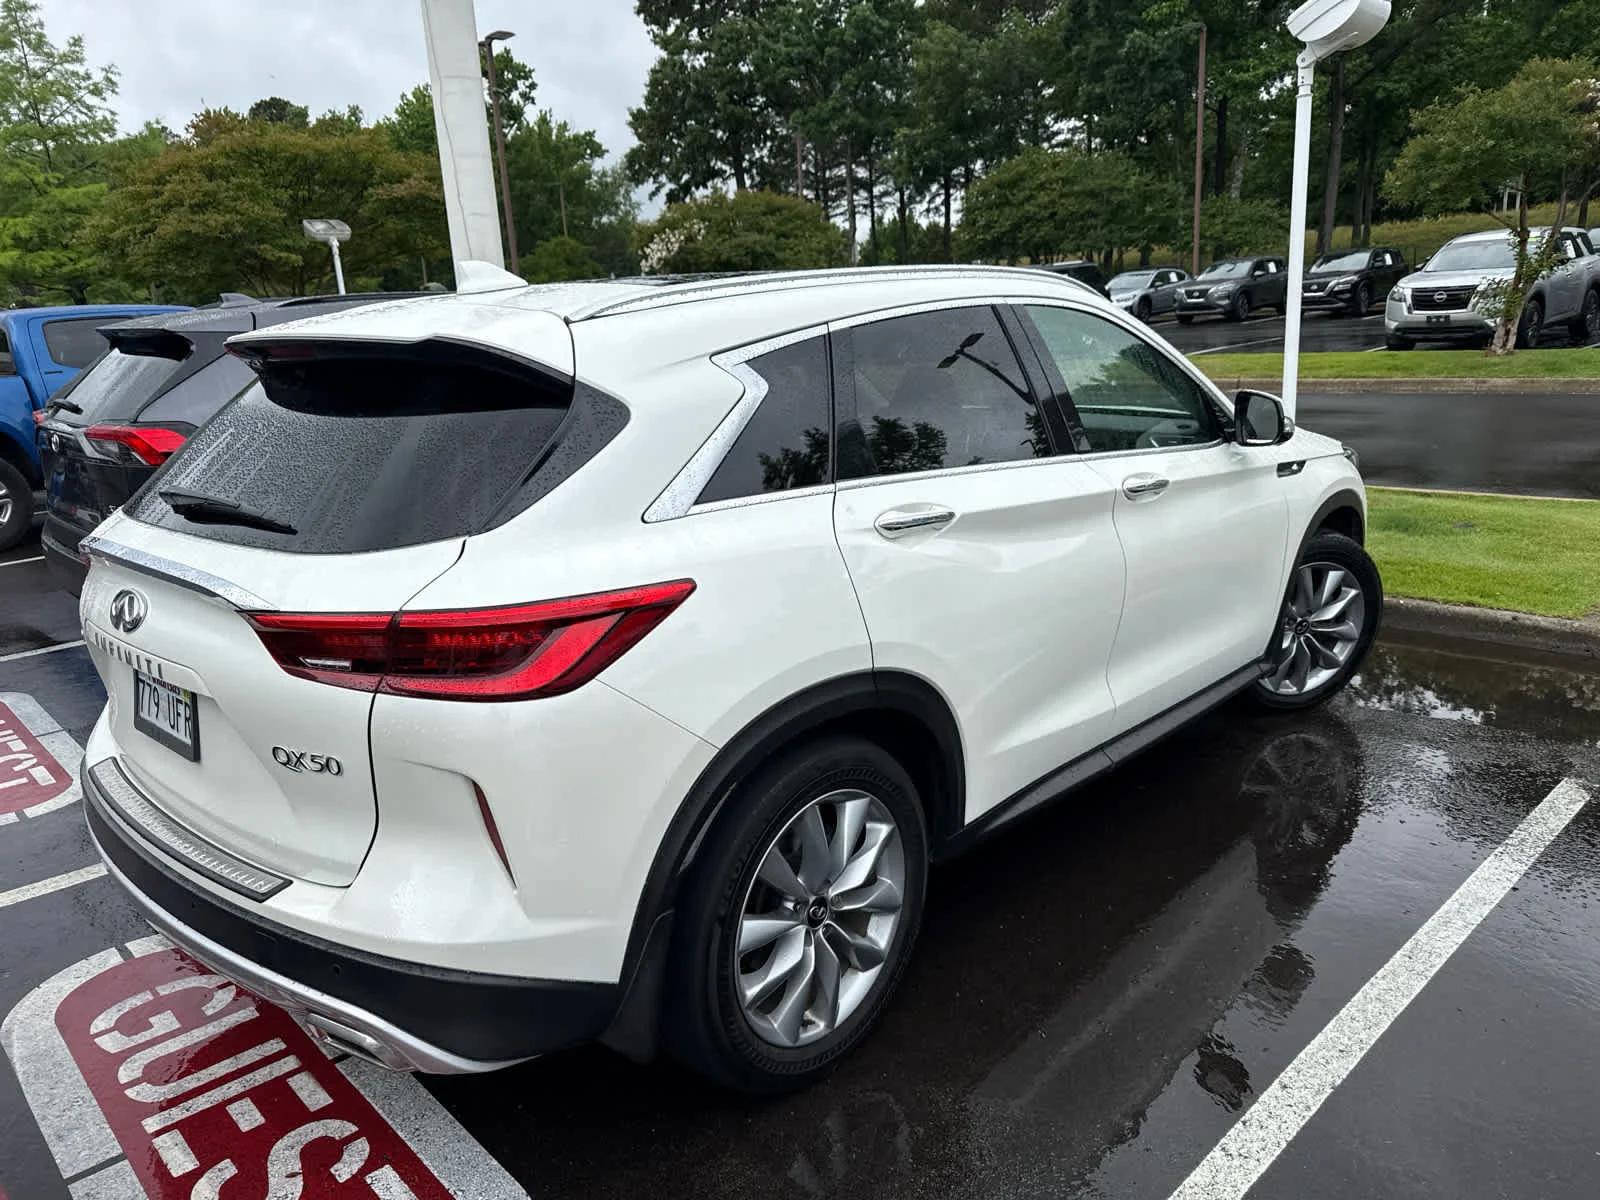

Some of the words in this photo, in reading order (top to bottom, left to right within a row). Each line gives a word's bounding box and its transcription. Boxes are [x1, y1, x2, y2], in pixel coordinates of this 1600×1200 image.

[139, 678, 160, 719] 779
[168, 692, 192, 740] UFR
[272, 745, 344, 776] QX50
[90, 974, 419, 1200] GUES
